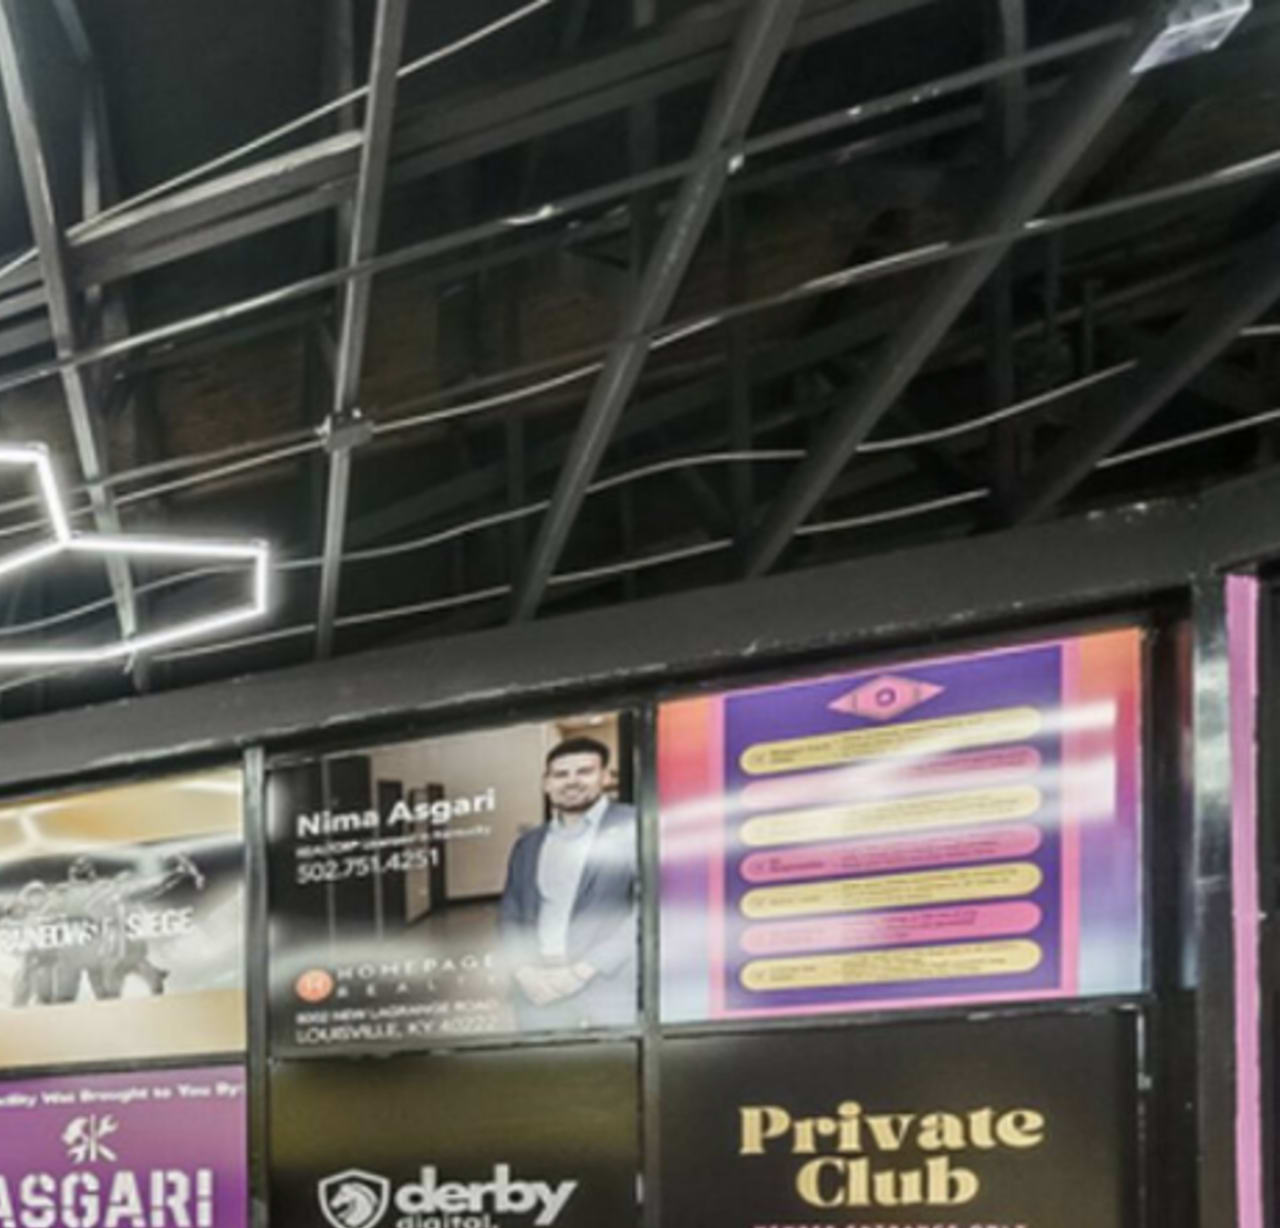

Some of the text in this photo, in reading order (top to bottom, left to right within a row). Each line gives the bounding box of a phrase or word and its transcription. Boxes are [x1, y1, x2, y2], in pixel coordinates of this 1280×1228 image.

[297, 787, 496, 838] Nima Asgari
[126, 905, 194, 940] SIEGE
[337, 954, 497, 980] HOMEPAGE
[739, 1101, 1044, 1154] Private
[394, 1163, 578, 1226] derby
[796, 1155, 979, 1207] Club
